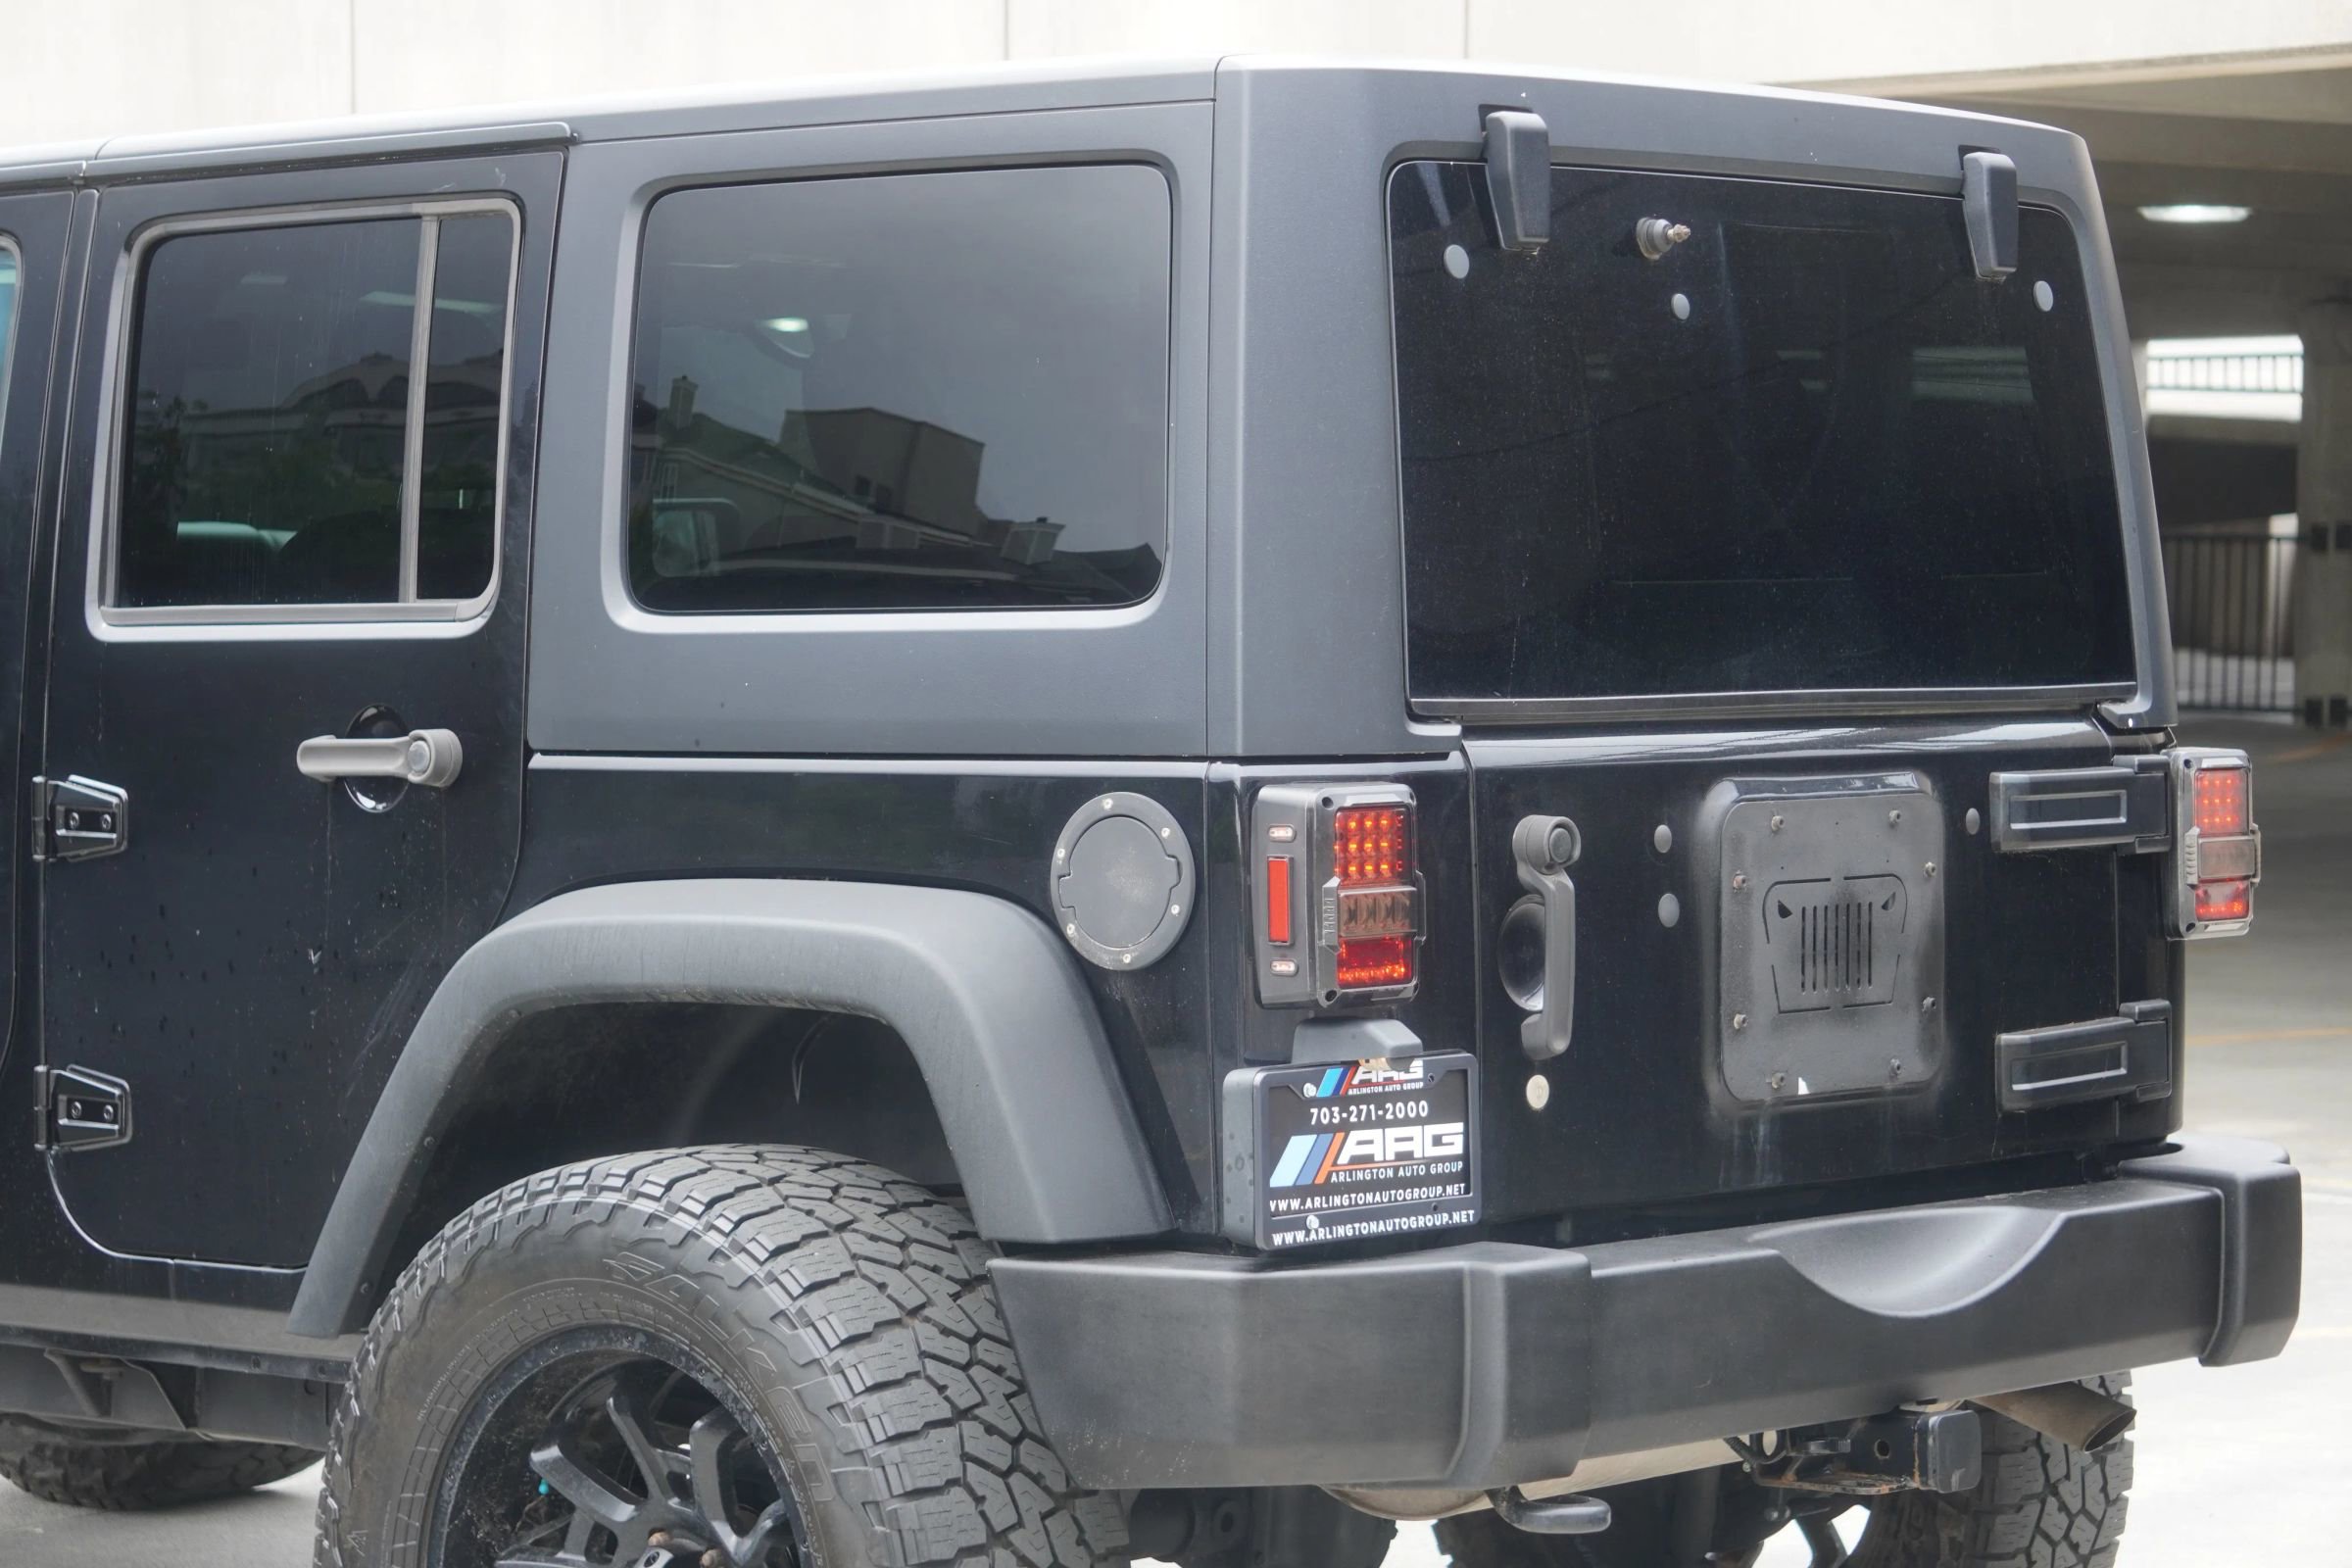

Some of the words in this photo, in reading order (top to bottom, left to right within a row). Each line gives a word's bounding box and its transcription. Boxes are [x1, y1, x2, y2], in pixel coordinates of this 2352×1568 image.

[1348, 1086, 1383, 1096] ARLINGTON
[1385, 1084, 1401, 1093] AUTO
[1402, 1082, 1424, 1091] GROUP
[1309, 1100, 1429, 1125] 703-271-2000
[1337, 1122, 1464, 1164] AAG
[1331, 1167, 1394, 1183] ARLINGTON
[1397, 1164, 1426, 1177] AUTO
[1430, 1161, 1463, 1174] GROUP
[1272, 1209, 1475, 1247] WWW.ARLINGTONAUTOGROUP.NET
